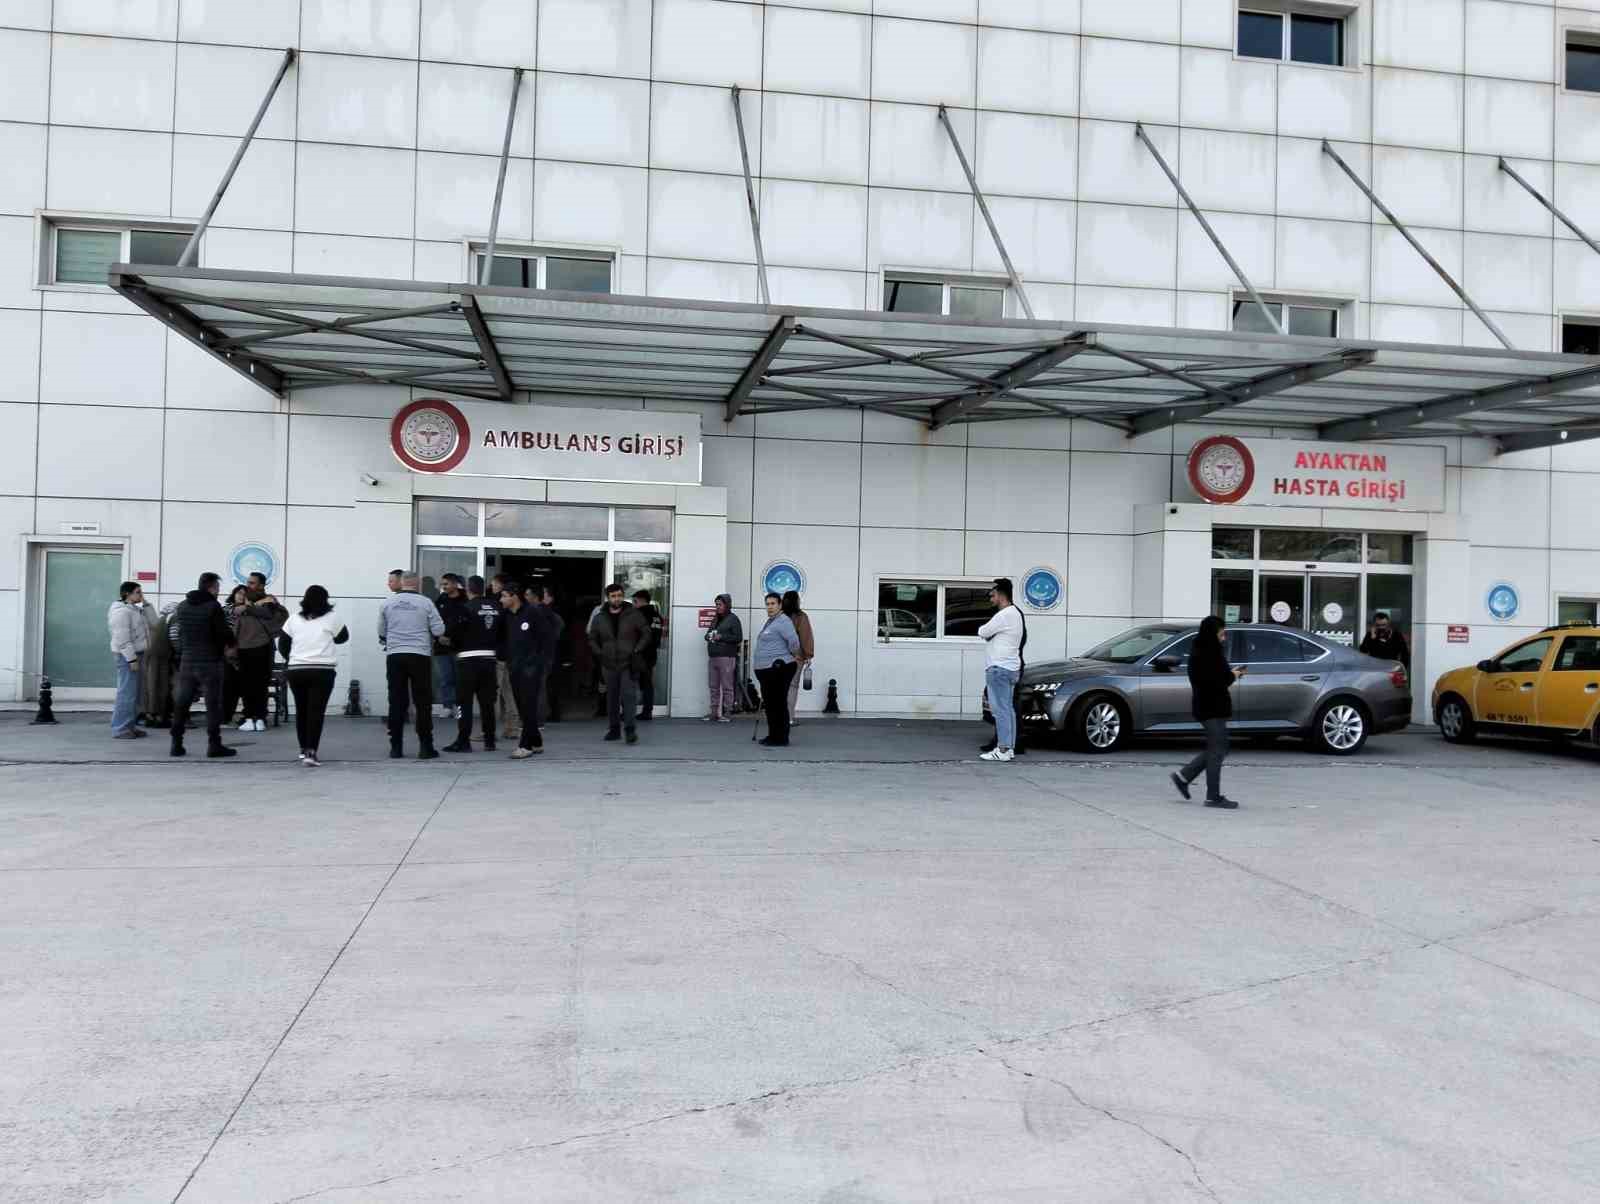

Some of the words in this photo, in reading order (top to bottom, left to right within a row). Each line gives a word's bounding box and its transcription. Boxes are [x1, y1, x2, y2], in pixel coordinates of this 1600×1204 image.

[483, 430, 611, 453] AMBULANS
[618, 433, 683, 460] GİRİŞİ
[1295, 451, 1387, 472] AYAKTAN
[1273, 478, 1340, 497] HASTA
[1346, 478, 1406, 503] GİRİŞİ
